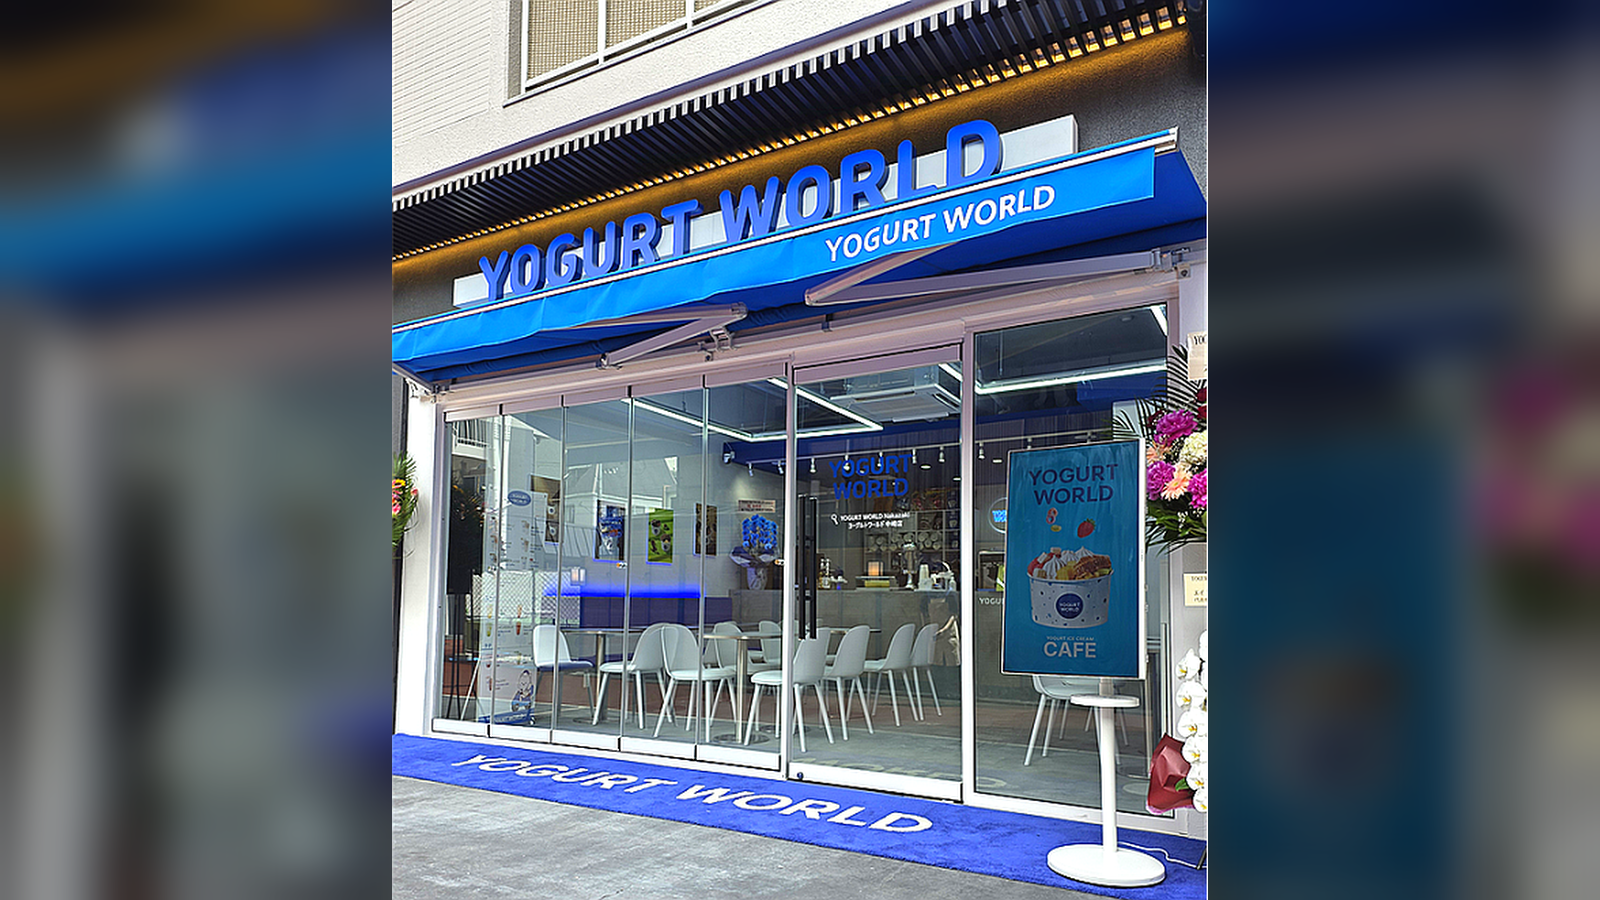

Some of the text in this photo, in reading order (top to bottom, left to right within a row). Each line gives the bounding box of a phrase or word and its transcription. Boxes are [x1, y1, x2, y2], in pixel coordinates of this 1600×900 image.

[478, 119, 1003, 302] YOGURT WORLD
[825, 184, 1056, 262] YOGURT WORLD
[828, 453, 912, 479] YOGURT
[1028, 463, 1118, 486] YOGURT
[832, 477, 909, 500] WORLD
[1033, 485, 1114, 506] WORLD
[840, 513, 862, 521] YOGURT
[862, 512, 883, 520] WORLD
[1043, 641, 1097, 658] CAFE
[451, 754, 933, 833] YOGURT WORLD
